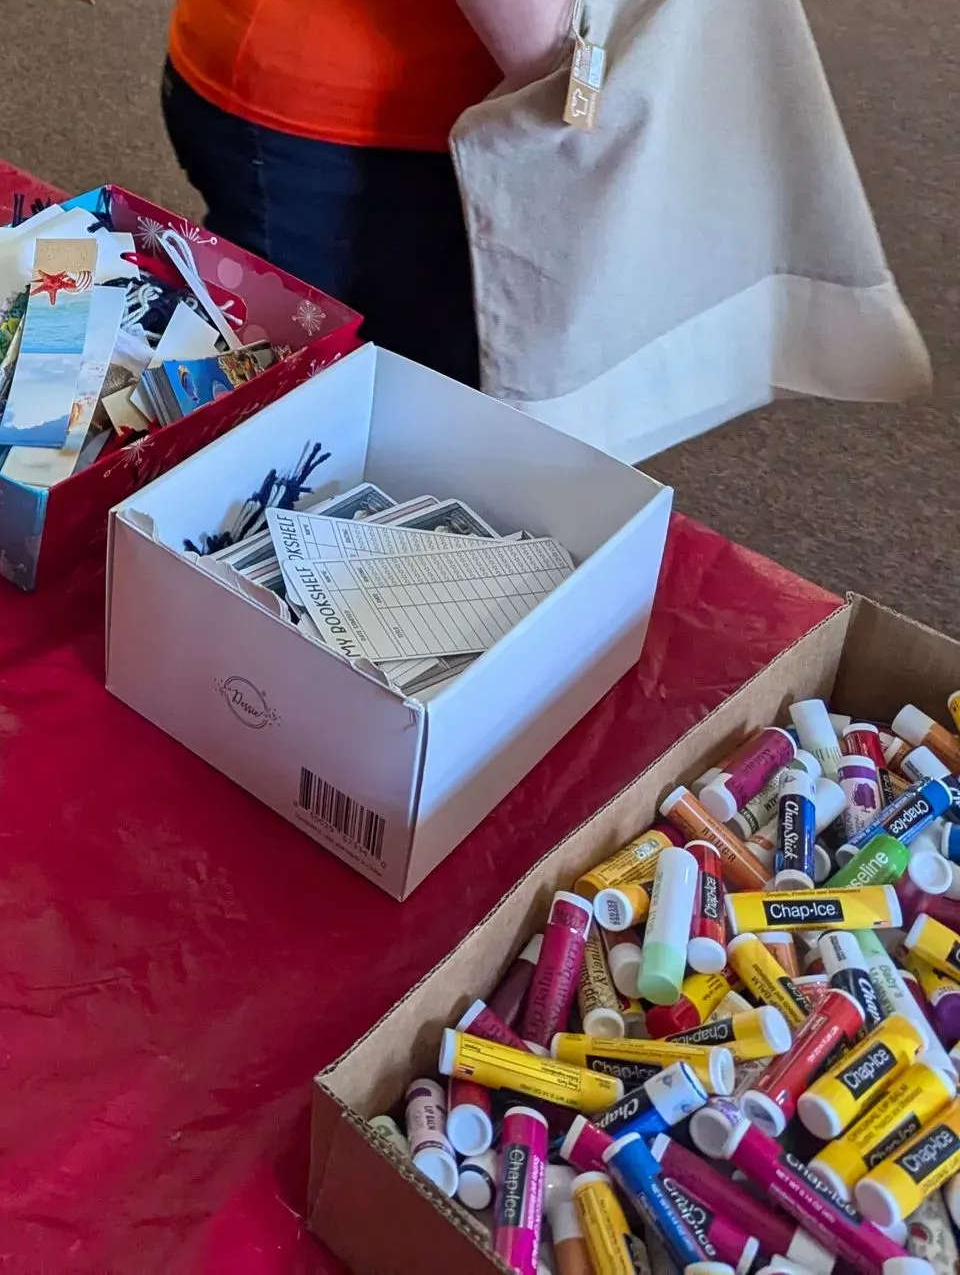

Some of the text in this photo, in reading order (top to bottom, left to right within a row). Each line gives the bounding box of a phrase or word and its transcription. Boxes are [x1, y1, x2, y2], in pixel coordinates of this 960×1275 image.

[295, 565, 361, 658] MY BOOKSHELF
[783, 799, 800, 860] ChapStick
[846, 849, 890, 889] seline
[423, 1105, 437, 1131] LIP BALM
